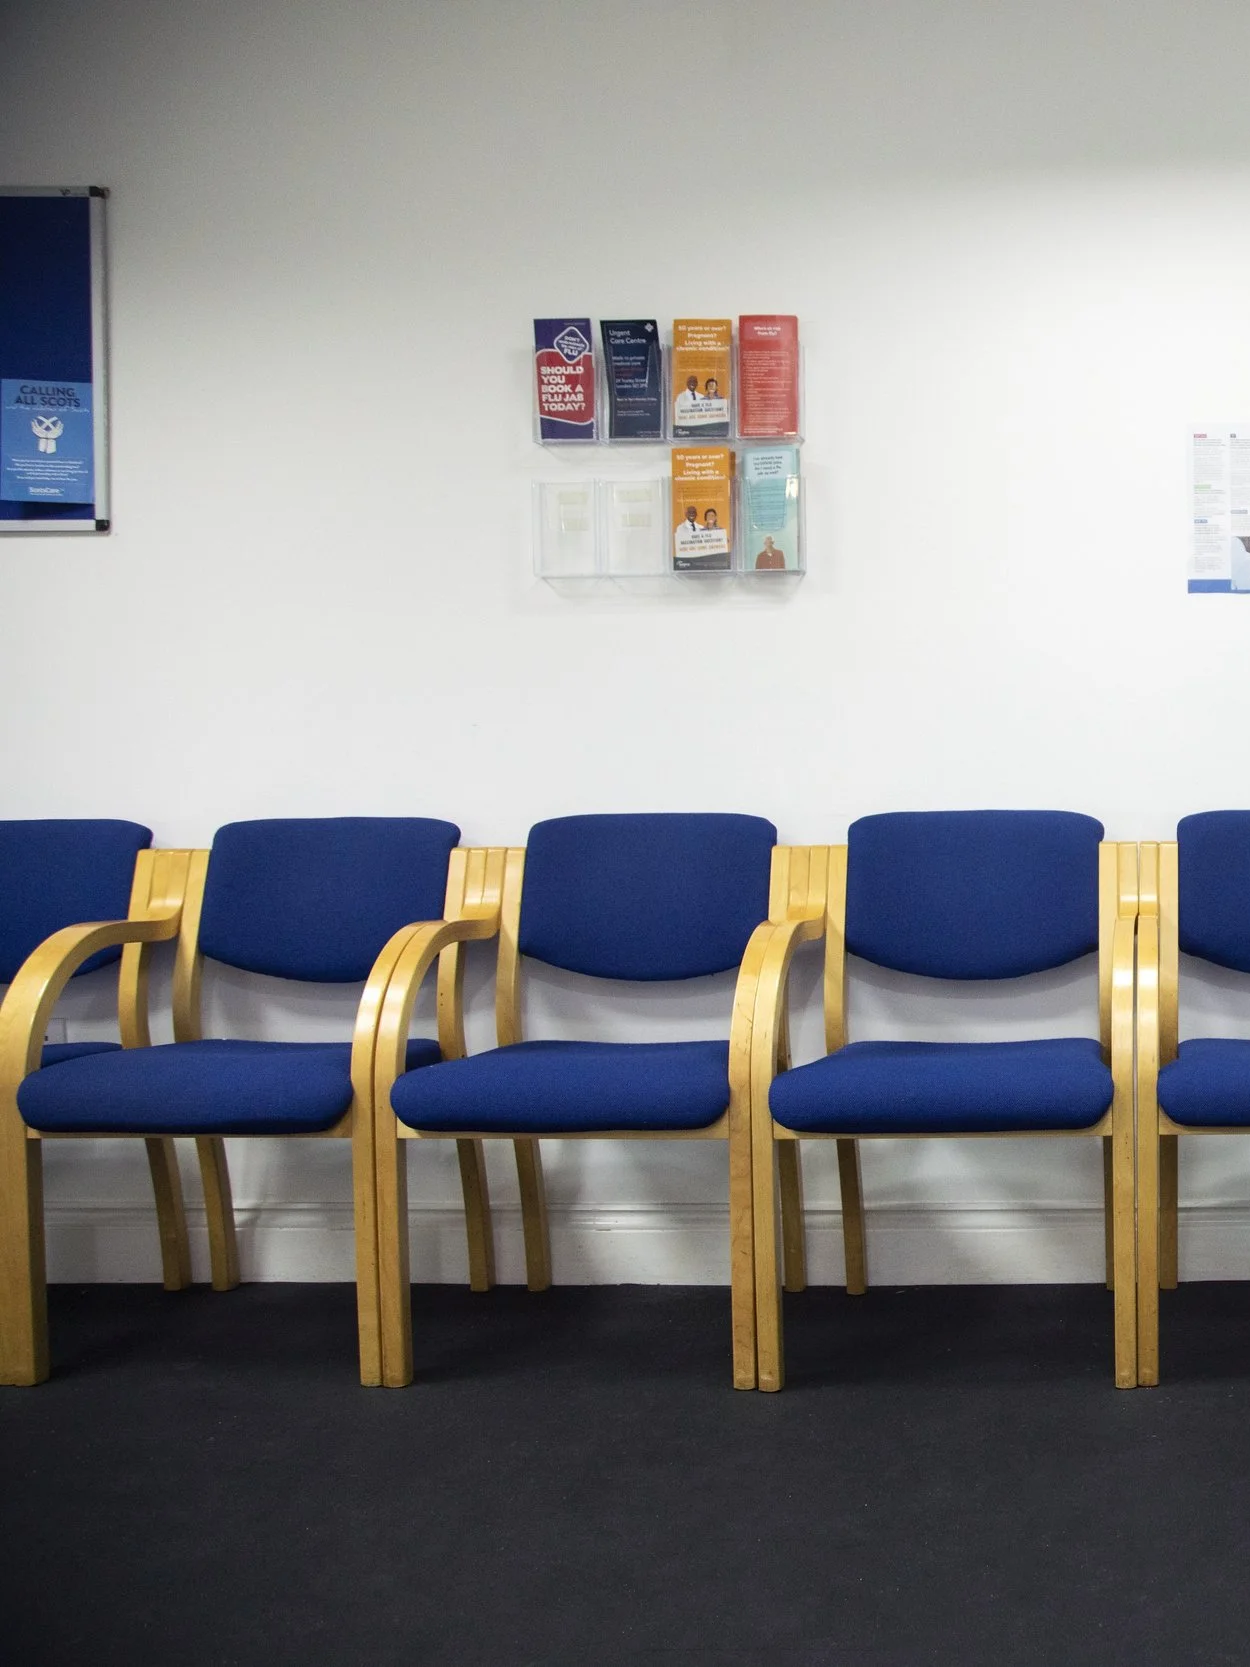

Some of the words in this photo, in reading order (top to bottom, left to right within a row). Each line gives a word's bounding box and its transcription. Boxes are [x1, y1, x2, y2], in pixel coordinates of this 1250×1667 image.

[608, 329, 631, 338] Urgent
[563, 348, 578, 356] FLU
[540, 366, 584, 375] SHOULD
[541, 375, 566, 384] YOU
[20, 385, 75, 397] CALLING
[541, 384, 573, 393] BOOK
[575, 384, 584, 393] A
[15, 396, 37, 406] ALL
[40, 397, 81, 408] SCOTS
[542, 393, 563, 402] FLU
[563, 393, 584, 402] JAB
[542, 402, 586, 412] TODAY?
[685, 461, 714, 469] Pregnant?
